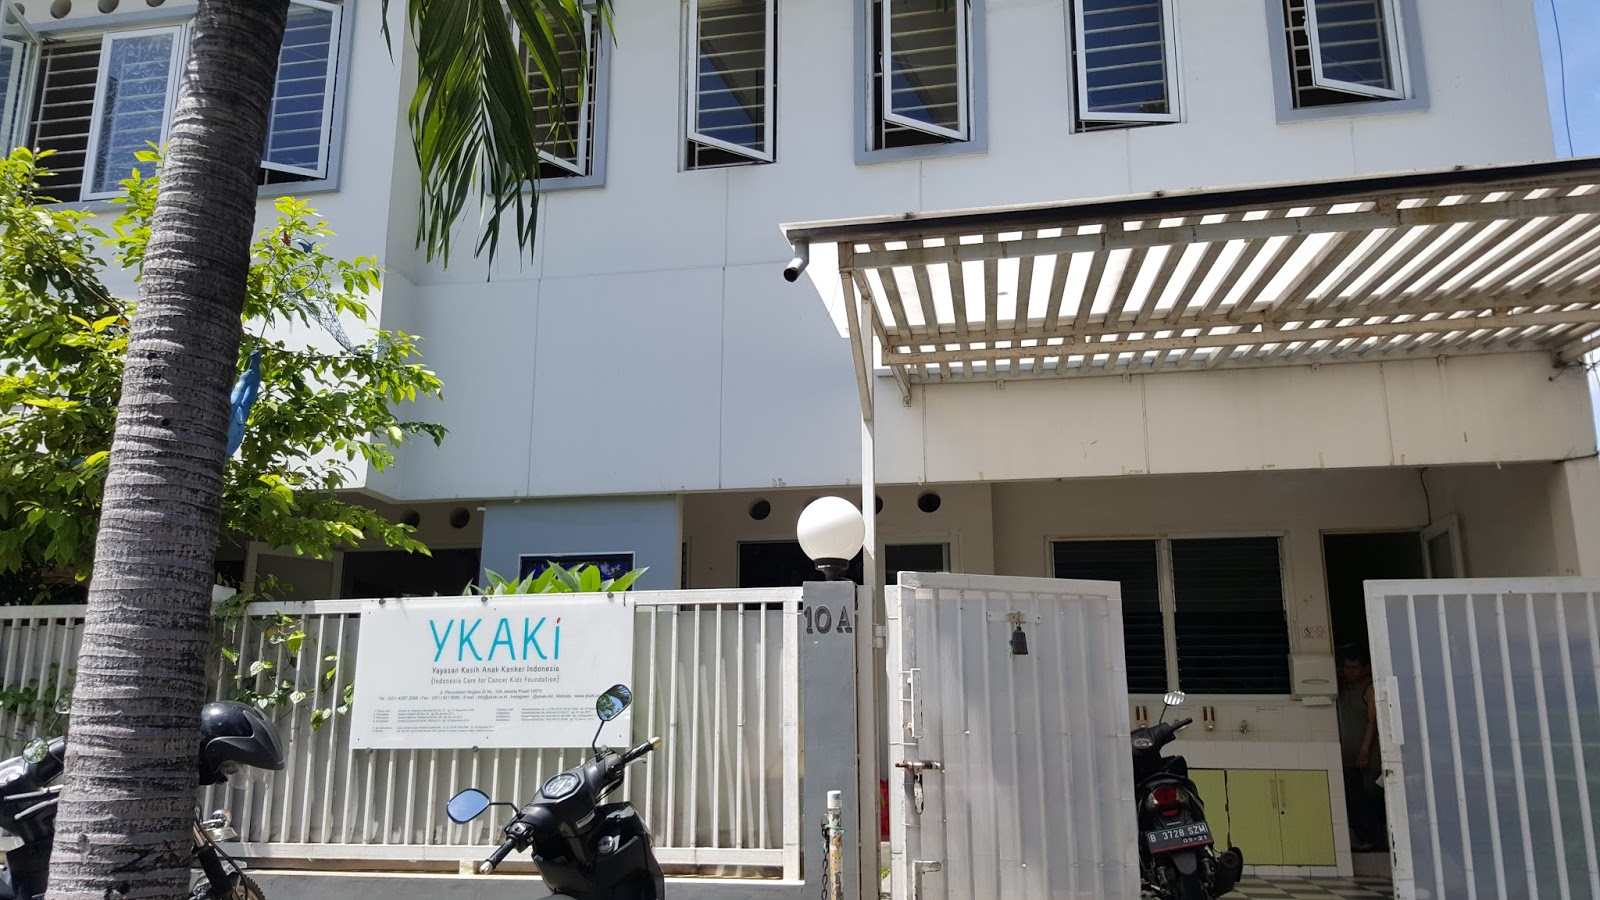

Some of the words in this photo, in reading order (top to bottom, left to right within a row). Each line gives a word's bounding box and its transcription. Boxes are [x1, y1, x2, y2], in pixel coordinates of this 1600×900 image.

[432, 666, 459, 675] Yayasan
[431, 677, 461, 685] (Indonesia
[524, 675, 560, 683] Foundation)
[1150, 834, 1157, 843] B
[1187, 824, 1206, 835] SZM
